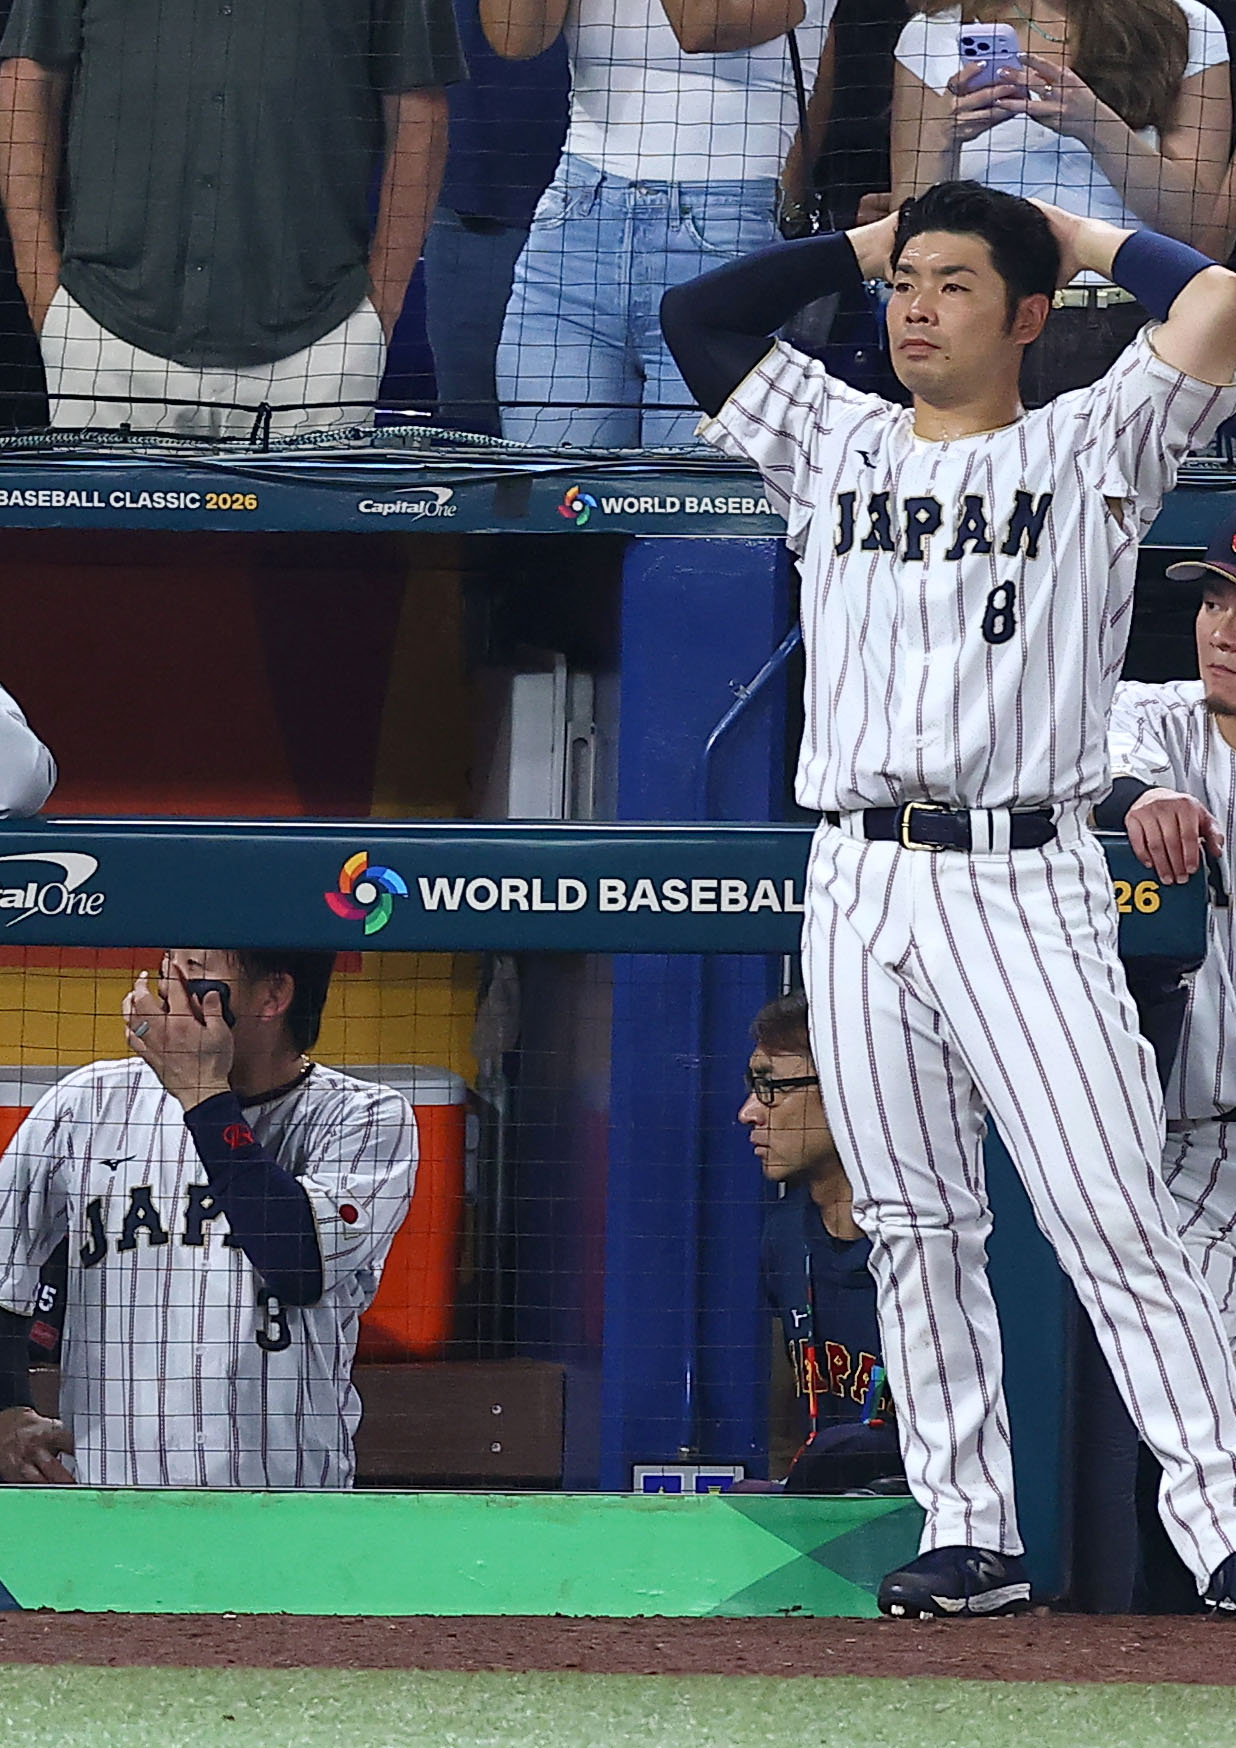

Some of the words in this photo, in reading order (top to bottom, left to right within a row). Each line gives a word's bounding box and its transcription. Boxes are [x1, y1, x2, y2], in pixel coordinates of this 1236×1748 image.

[0, 490, 106, 508] BASEBALL
[109, 491, 201, 509] CLASSIC
[205, 493, 258, 510] 2026
[601, 497, 680, 514] WORLD
[834, 489, 1053, 563] JAPAN
[982, 579, 1017, 645] 8
[418, 876, 587, 912] WORLD
